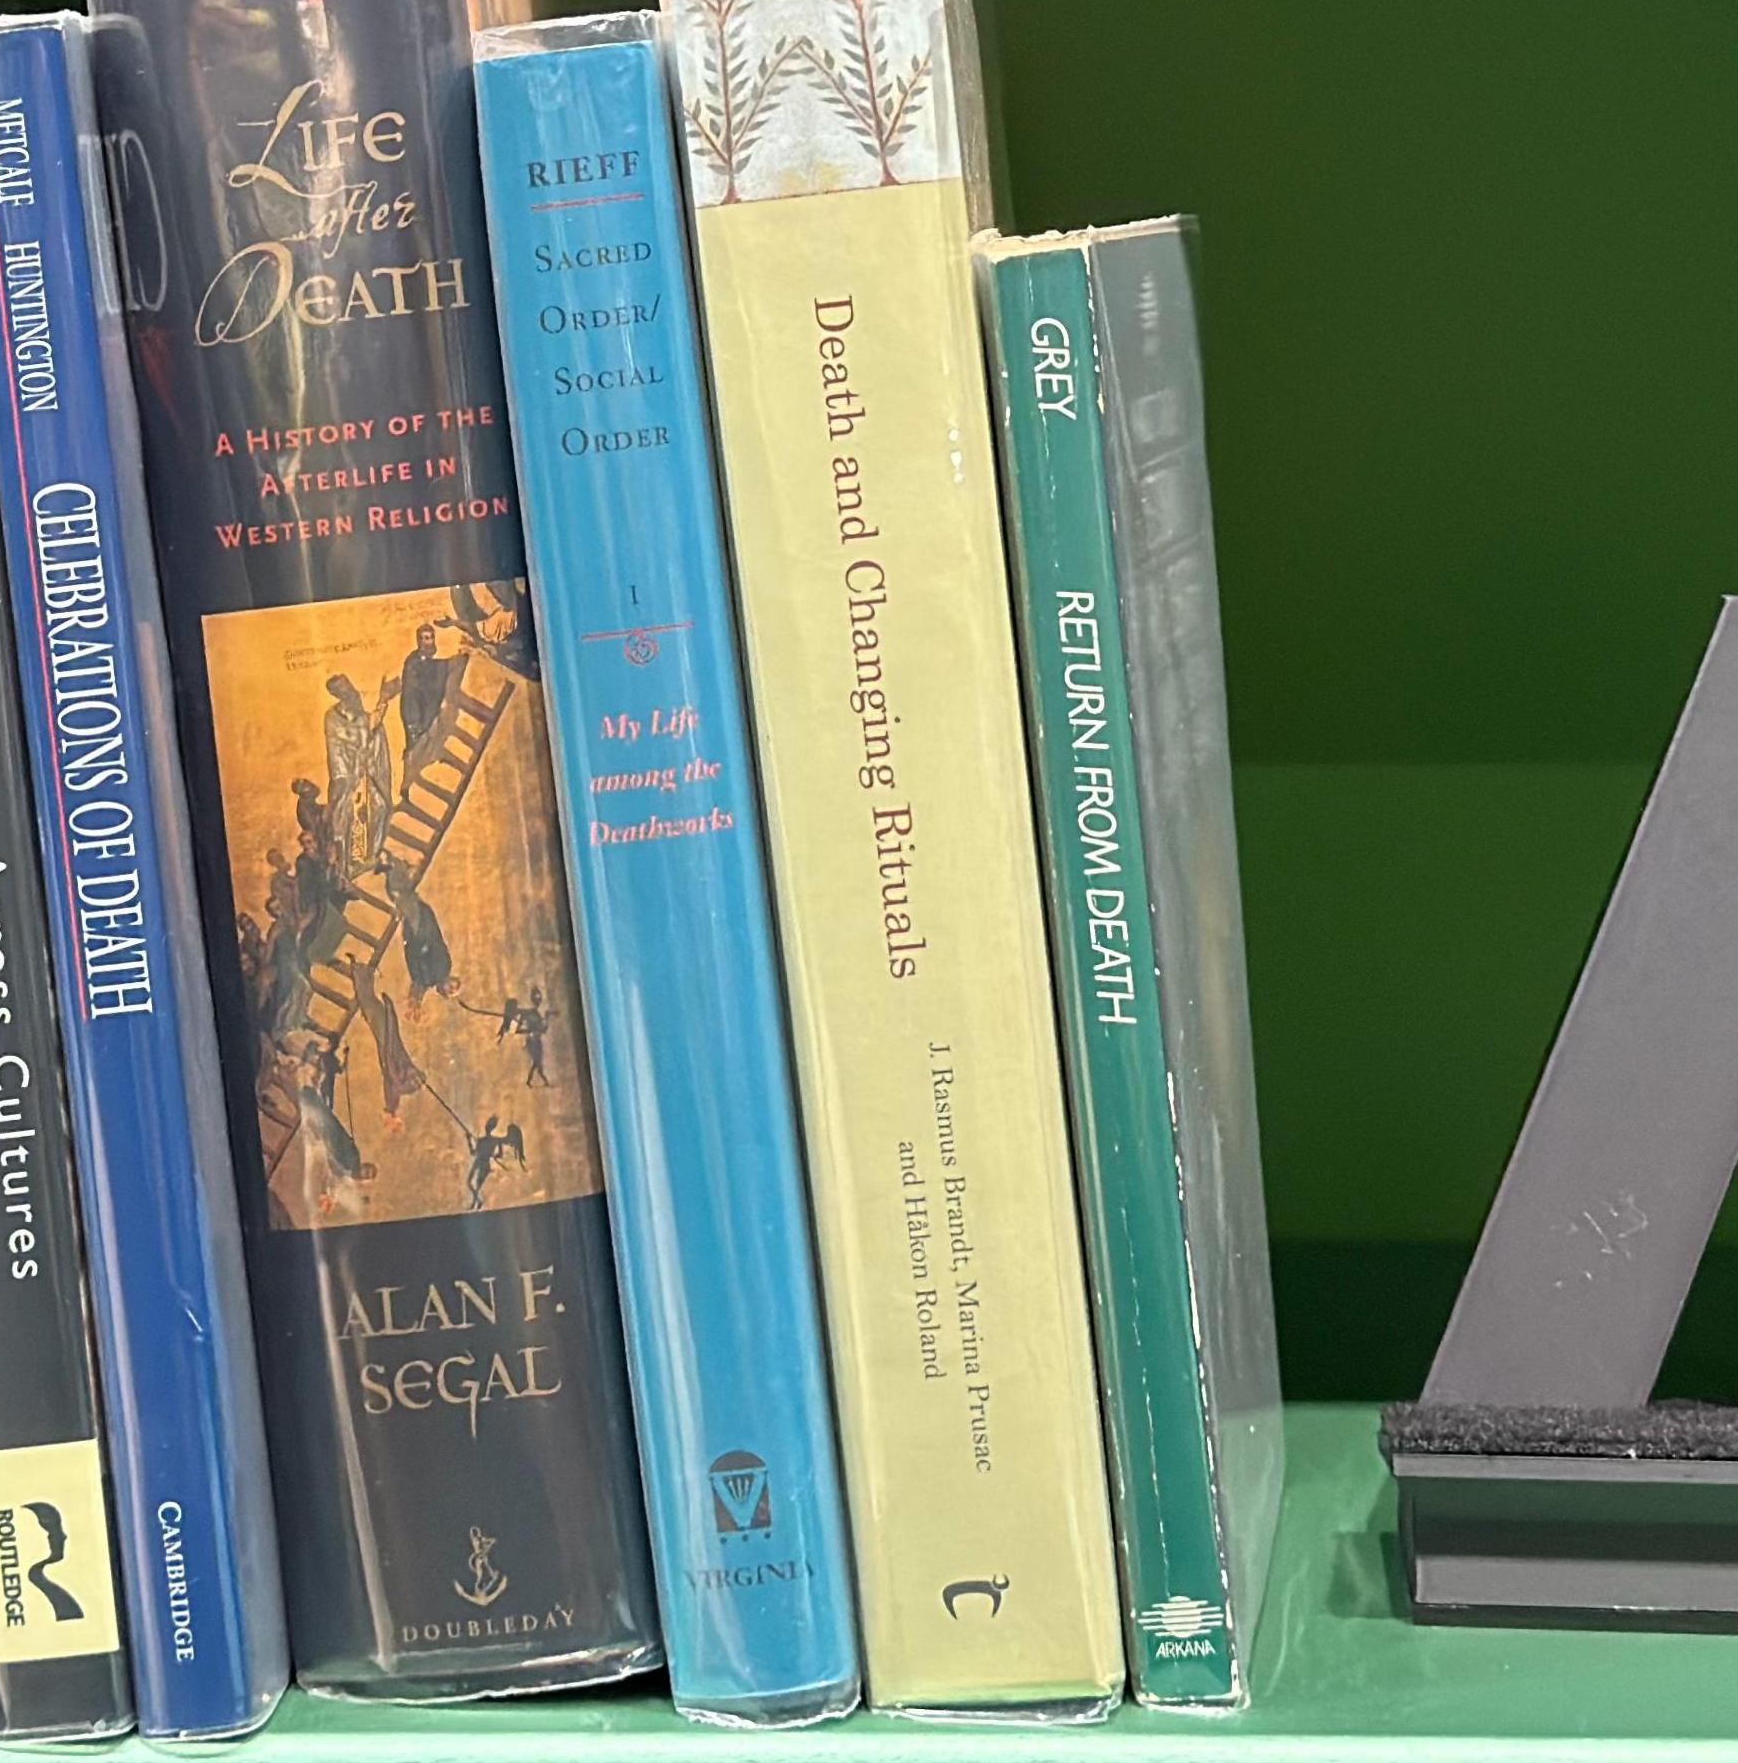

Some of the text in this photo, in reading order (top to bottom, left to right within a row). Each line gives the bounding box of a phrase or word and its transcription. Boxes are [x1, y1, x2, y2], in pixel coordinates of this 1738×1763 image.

[526, 150, 640, 189] RIEFF
[282, 181, 418, 258] after
[534, 241, 653, 273] SACRED
[194, 241, 471, 347] DEATH
[540, 295, 662, 334] ORDER/
[4, 240, 59, 412] HUNTINGTON
[554, 365, 663, 397] SOCIAL
[1031, 317, 1078, 421] GREY
[215, 405, 495, 456] A HISTORY OF THE
[562, 425, 670, 457] ORDER
[261, 455, 457, 497] AFTERLIFE IN
[215, 497, 509, 549] WESTERN RELIGION
[814, 294, 926, 980] Death and Changing Rituals
[600, 706, 699, 741] My Life
[33, 482, 154, 1021] CELEBRATIONS OF DEATH
[590, 757, 721, 796] among the
[590, 807, 734, 845] Deathworks
[1056, 590, 1136, 1027] RETURN FROM DEATH
[897, 1139, 947, 1380] and Håkon Roland
[929, 1041, 992, 1474] J. Rasmus Brandt, Marina Prusac
[338, 1265, 566, 1339] ALAN F.
[361, 1346, 562, 1437] SEGAL
[156, 1501, 196, 1663] CAMBRIDGE
[684, 1562, 815, 1594] VIRGINIA
[402, 1608, 575, 1643] DOUBLEDAY
[1154, 1639, 1217, 1659] ARKANA
